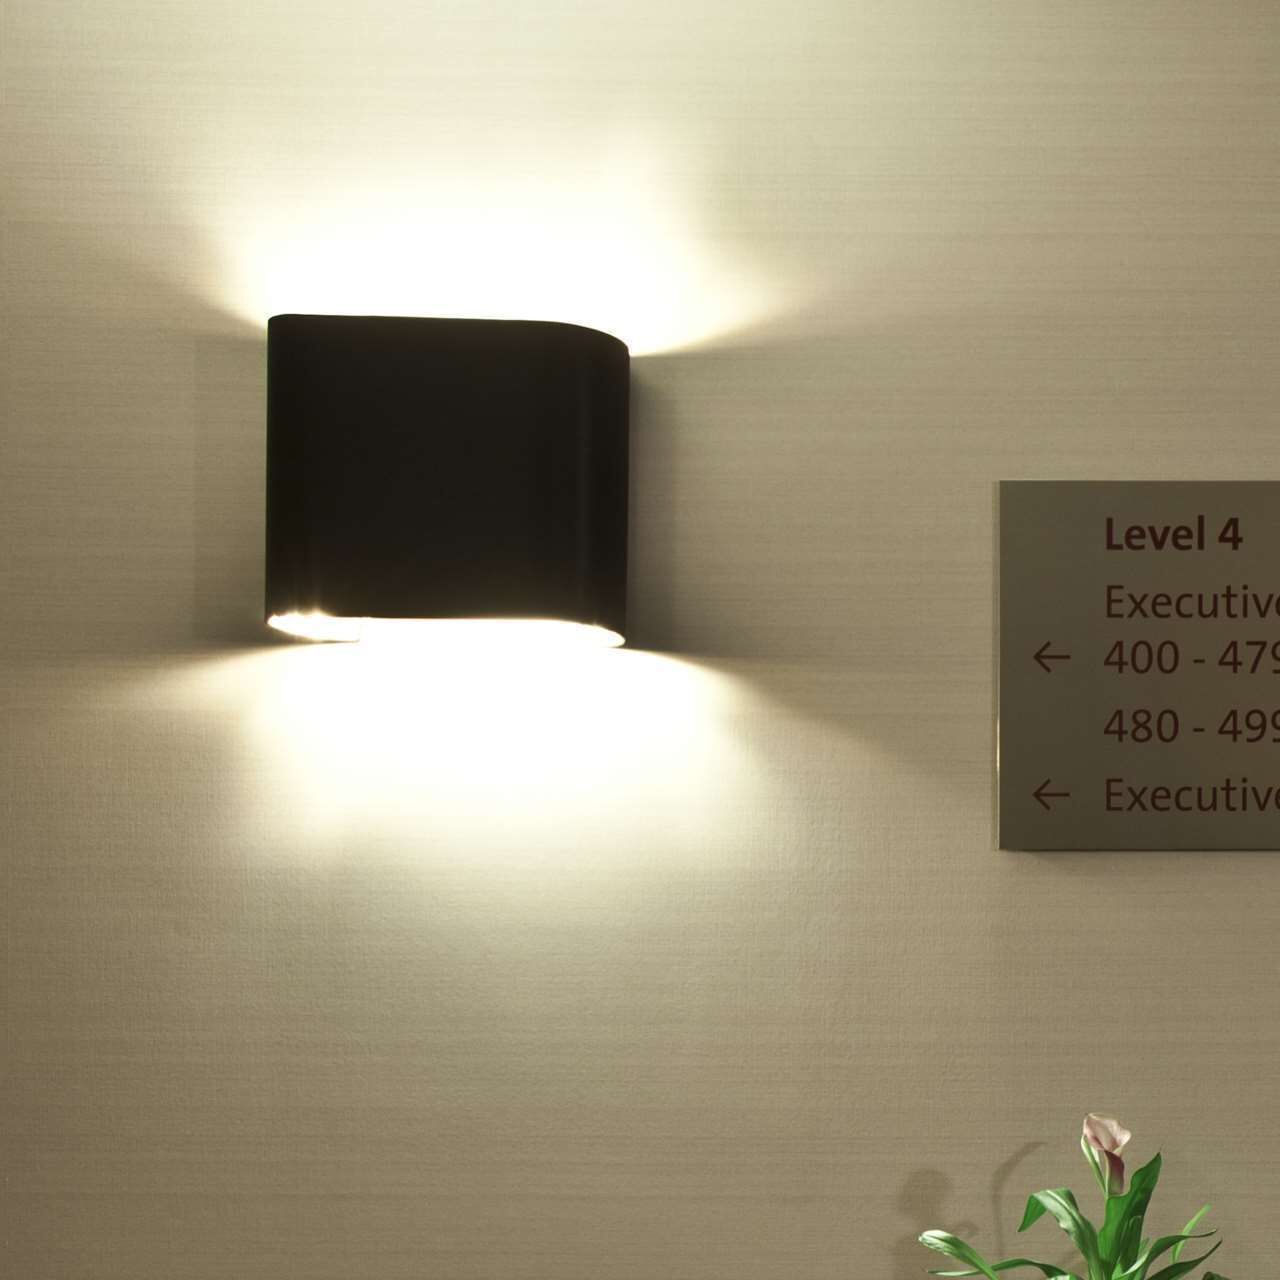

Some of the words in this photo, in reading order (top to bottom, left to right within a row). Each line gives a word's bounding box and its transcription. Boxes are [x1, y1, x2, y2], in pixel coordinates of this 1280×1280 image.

[1106, 514, 1205, 551] Level
[1217, 517, 1244, 551] 4
[1103, 639, 1180, 675] 400
[1103, 708, 1180, 744] 480
